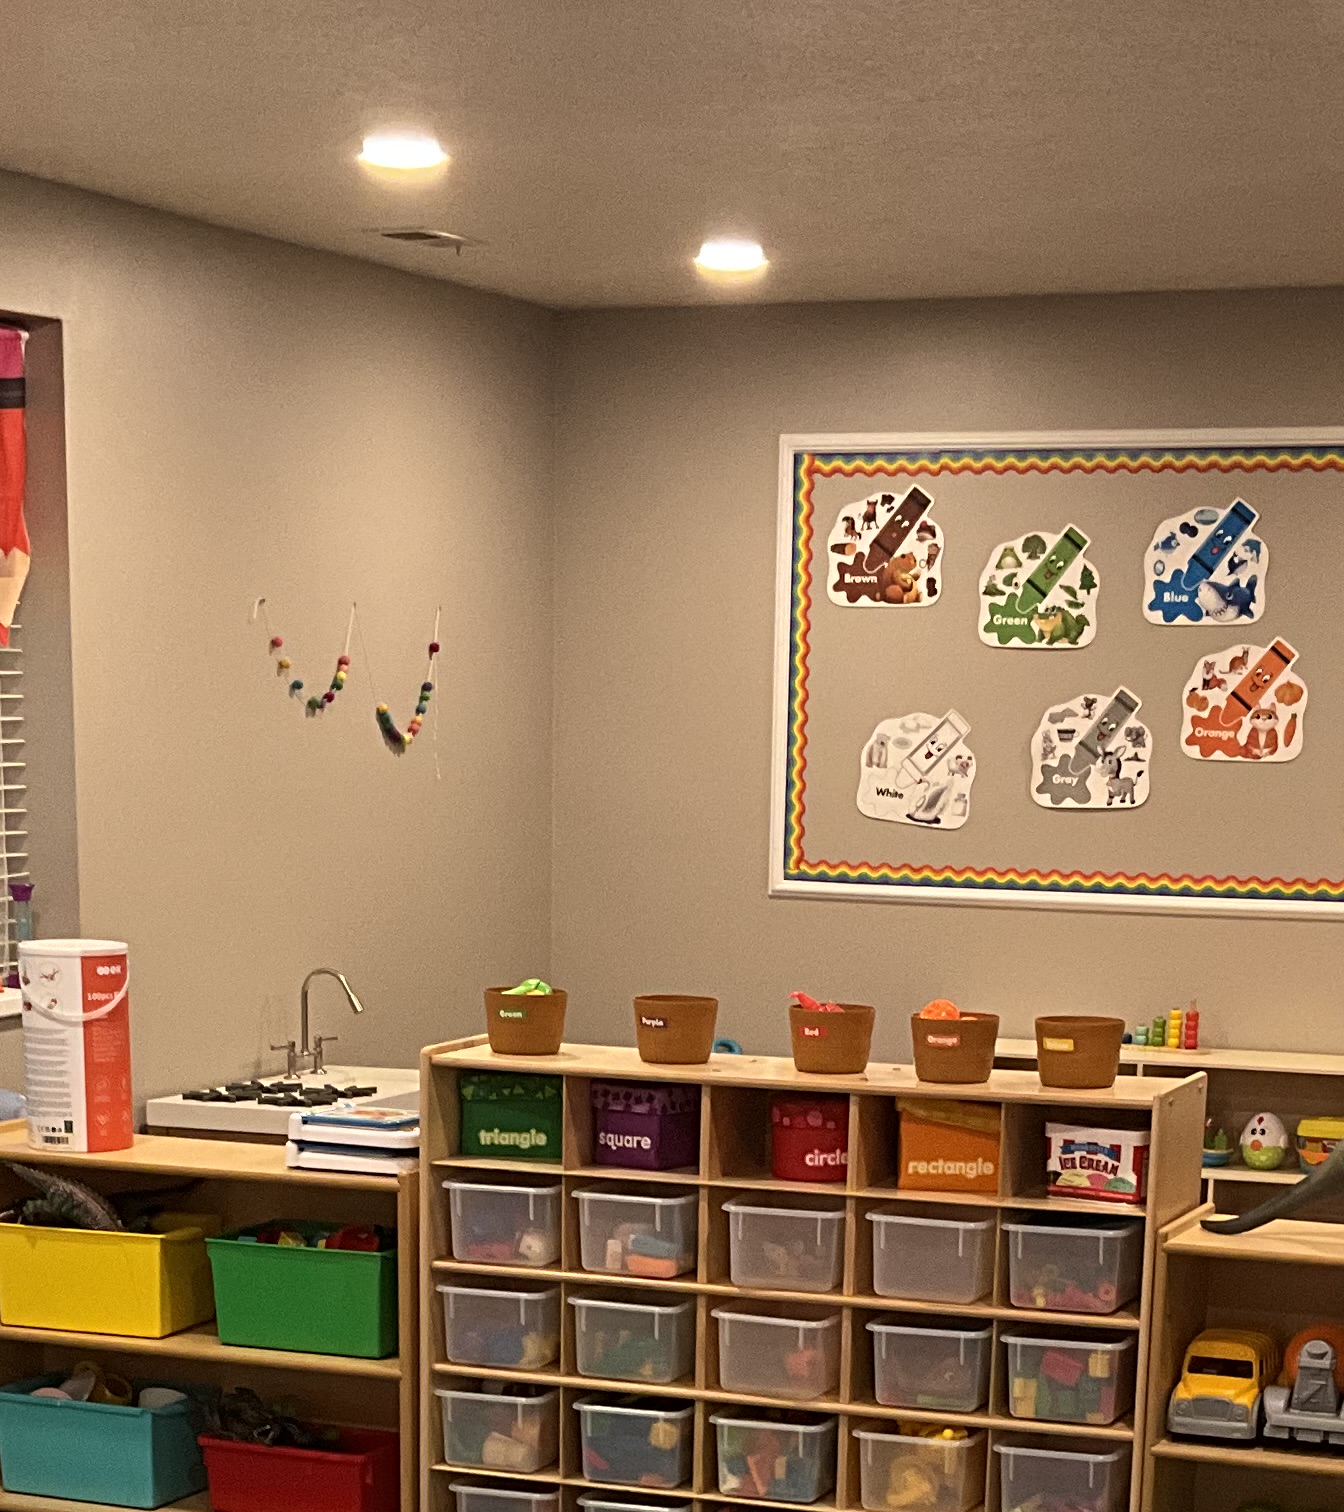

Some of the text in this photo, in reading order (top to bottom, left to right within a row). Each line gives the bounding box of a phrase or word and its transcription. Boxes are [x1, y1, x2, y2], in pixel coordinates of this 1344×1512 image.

[844, 573, 878, 584] Brown
[1163, 592, 1189, 603] Blue
[993, 614, 1028, 626] Green
[1195, 727, 1236, 741] Orange
[1052, 774, 1079, 787] Gray
[876, 787, 905, 800] White
[804, 1027, 819, 1037] Red
[927, 1034, 958, 1047] Orange
[479, 1127, 547, 1149] triangle
[599, 1131, 652, 1150] square
[908, 1157, 994, 1178] rectangle
[1058, 1155, 1120, 1177] ICE CREAM
